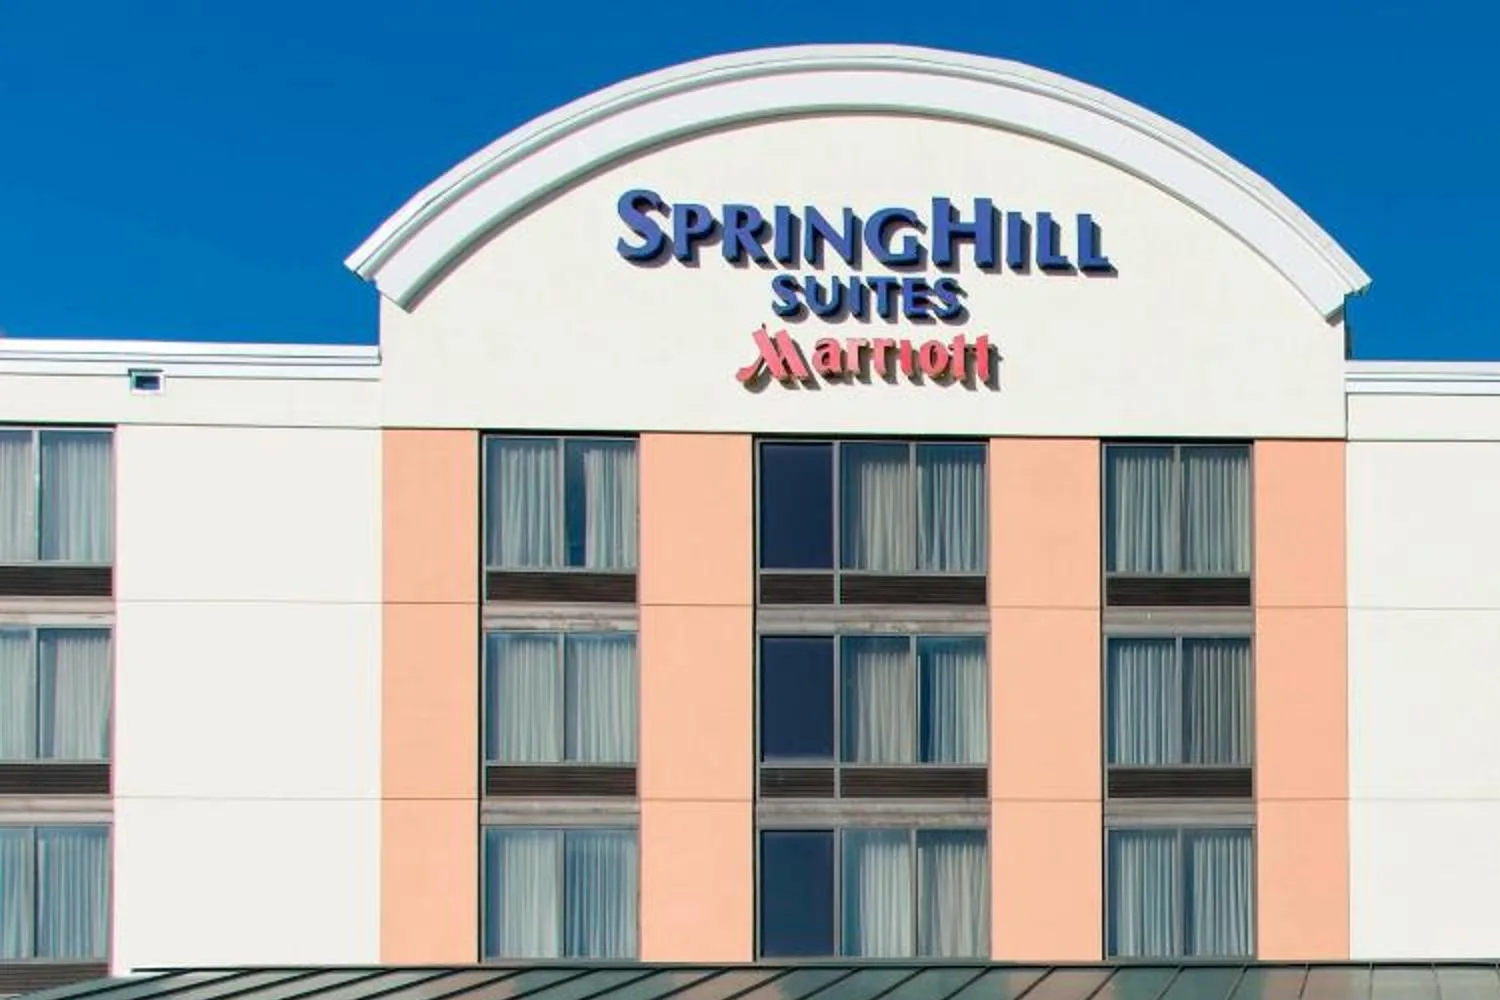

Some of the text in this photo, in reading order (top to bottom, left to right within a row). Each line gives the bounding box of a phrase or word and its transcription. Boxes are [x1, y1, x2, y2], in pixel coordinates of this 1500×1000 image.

[616, 188, 1117, 274] SPRINGHILL
[770, 274, 967, 322] SUITES
[736, 325, 997, 386] Marriott
